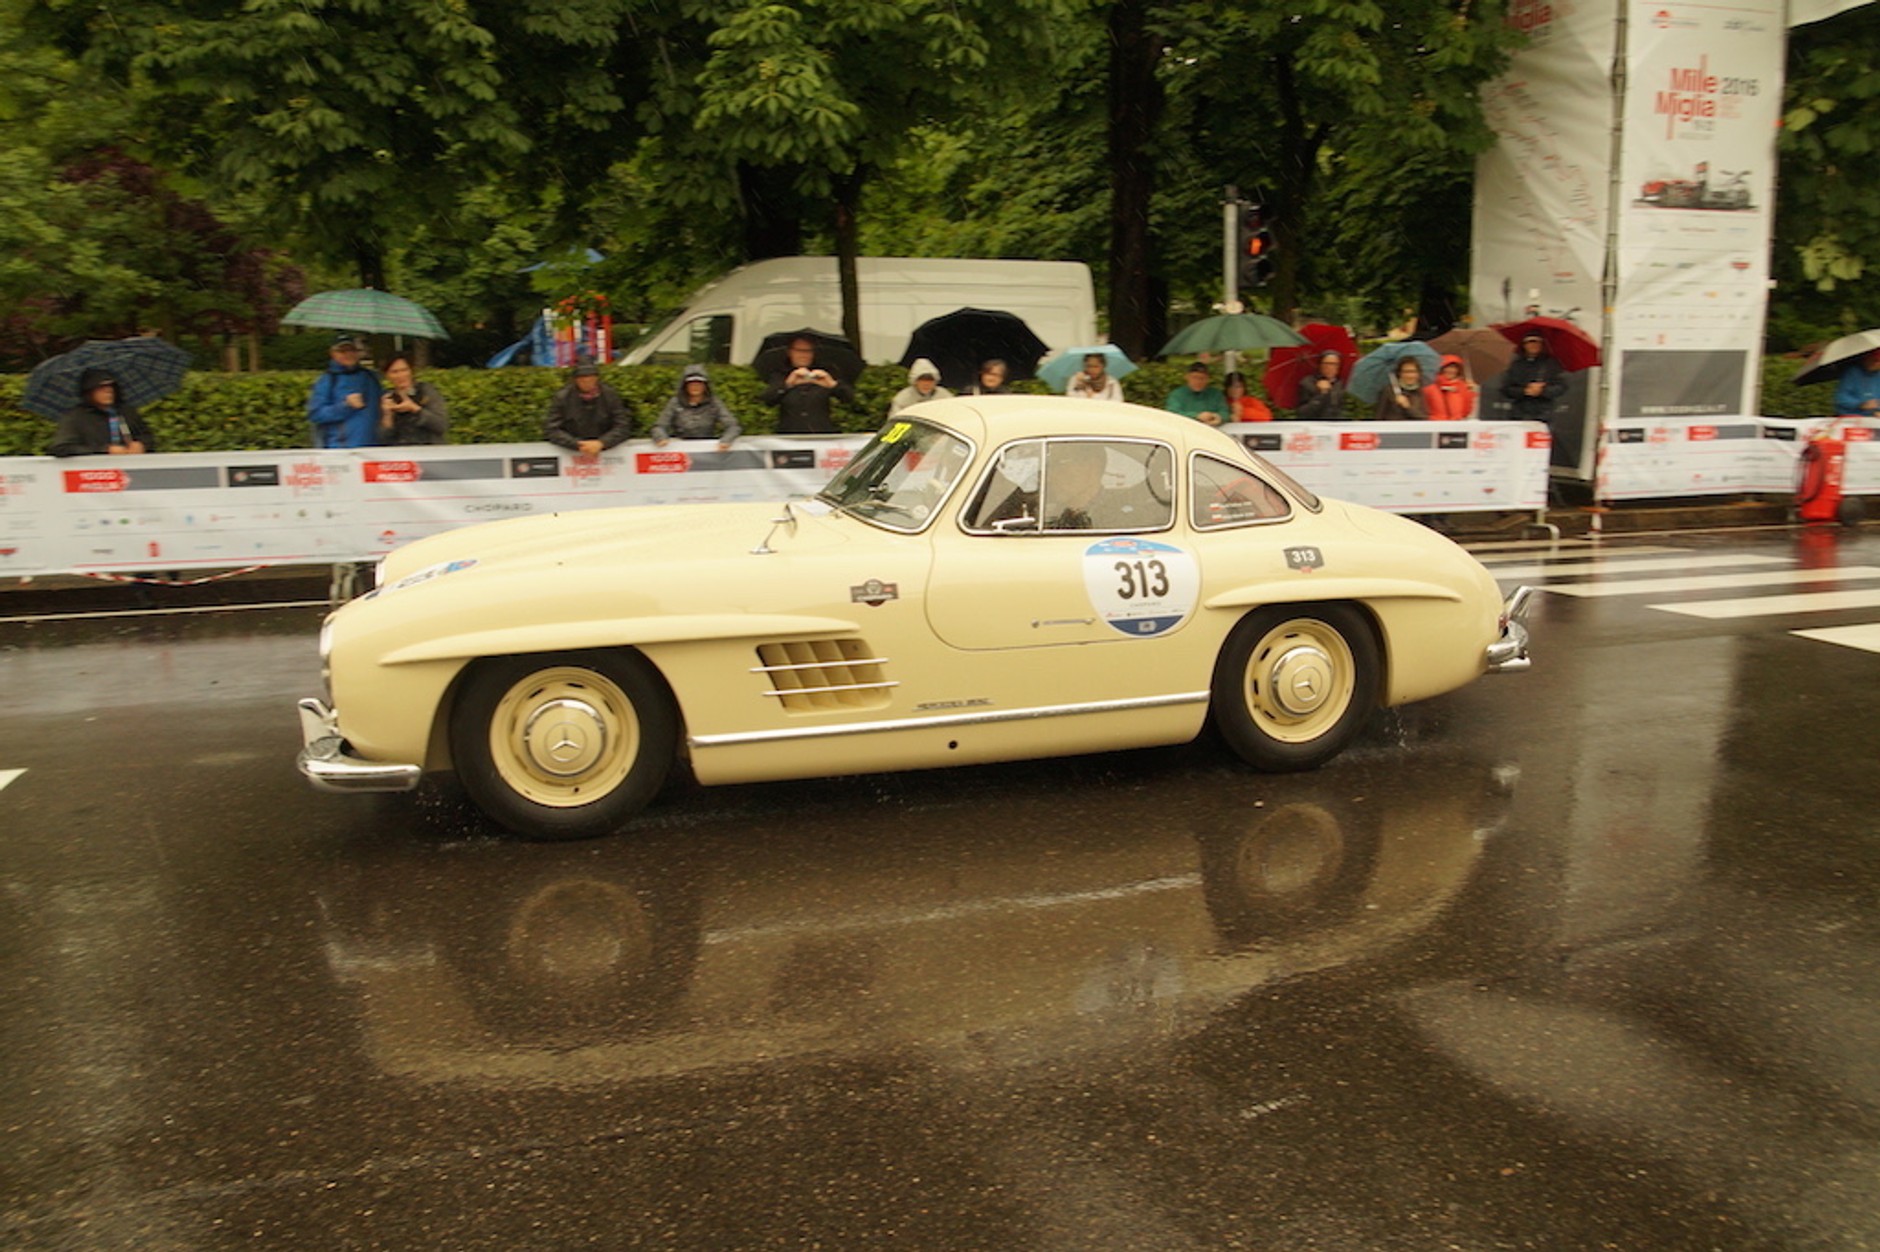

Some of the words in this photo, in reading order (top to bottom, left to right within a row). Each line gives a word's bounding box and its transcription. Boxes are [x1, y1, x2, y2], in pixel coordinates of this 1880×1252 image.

[1669, 56, 1718, 93] Mille
[1721, 77, 1759, 96] 2016
[1655, 91, 1716, 136] Miglia
[1290, 549, 1316, 563] 313
[1114, 559, 1169, 600] 313
